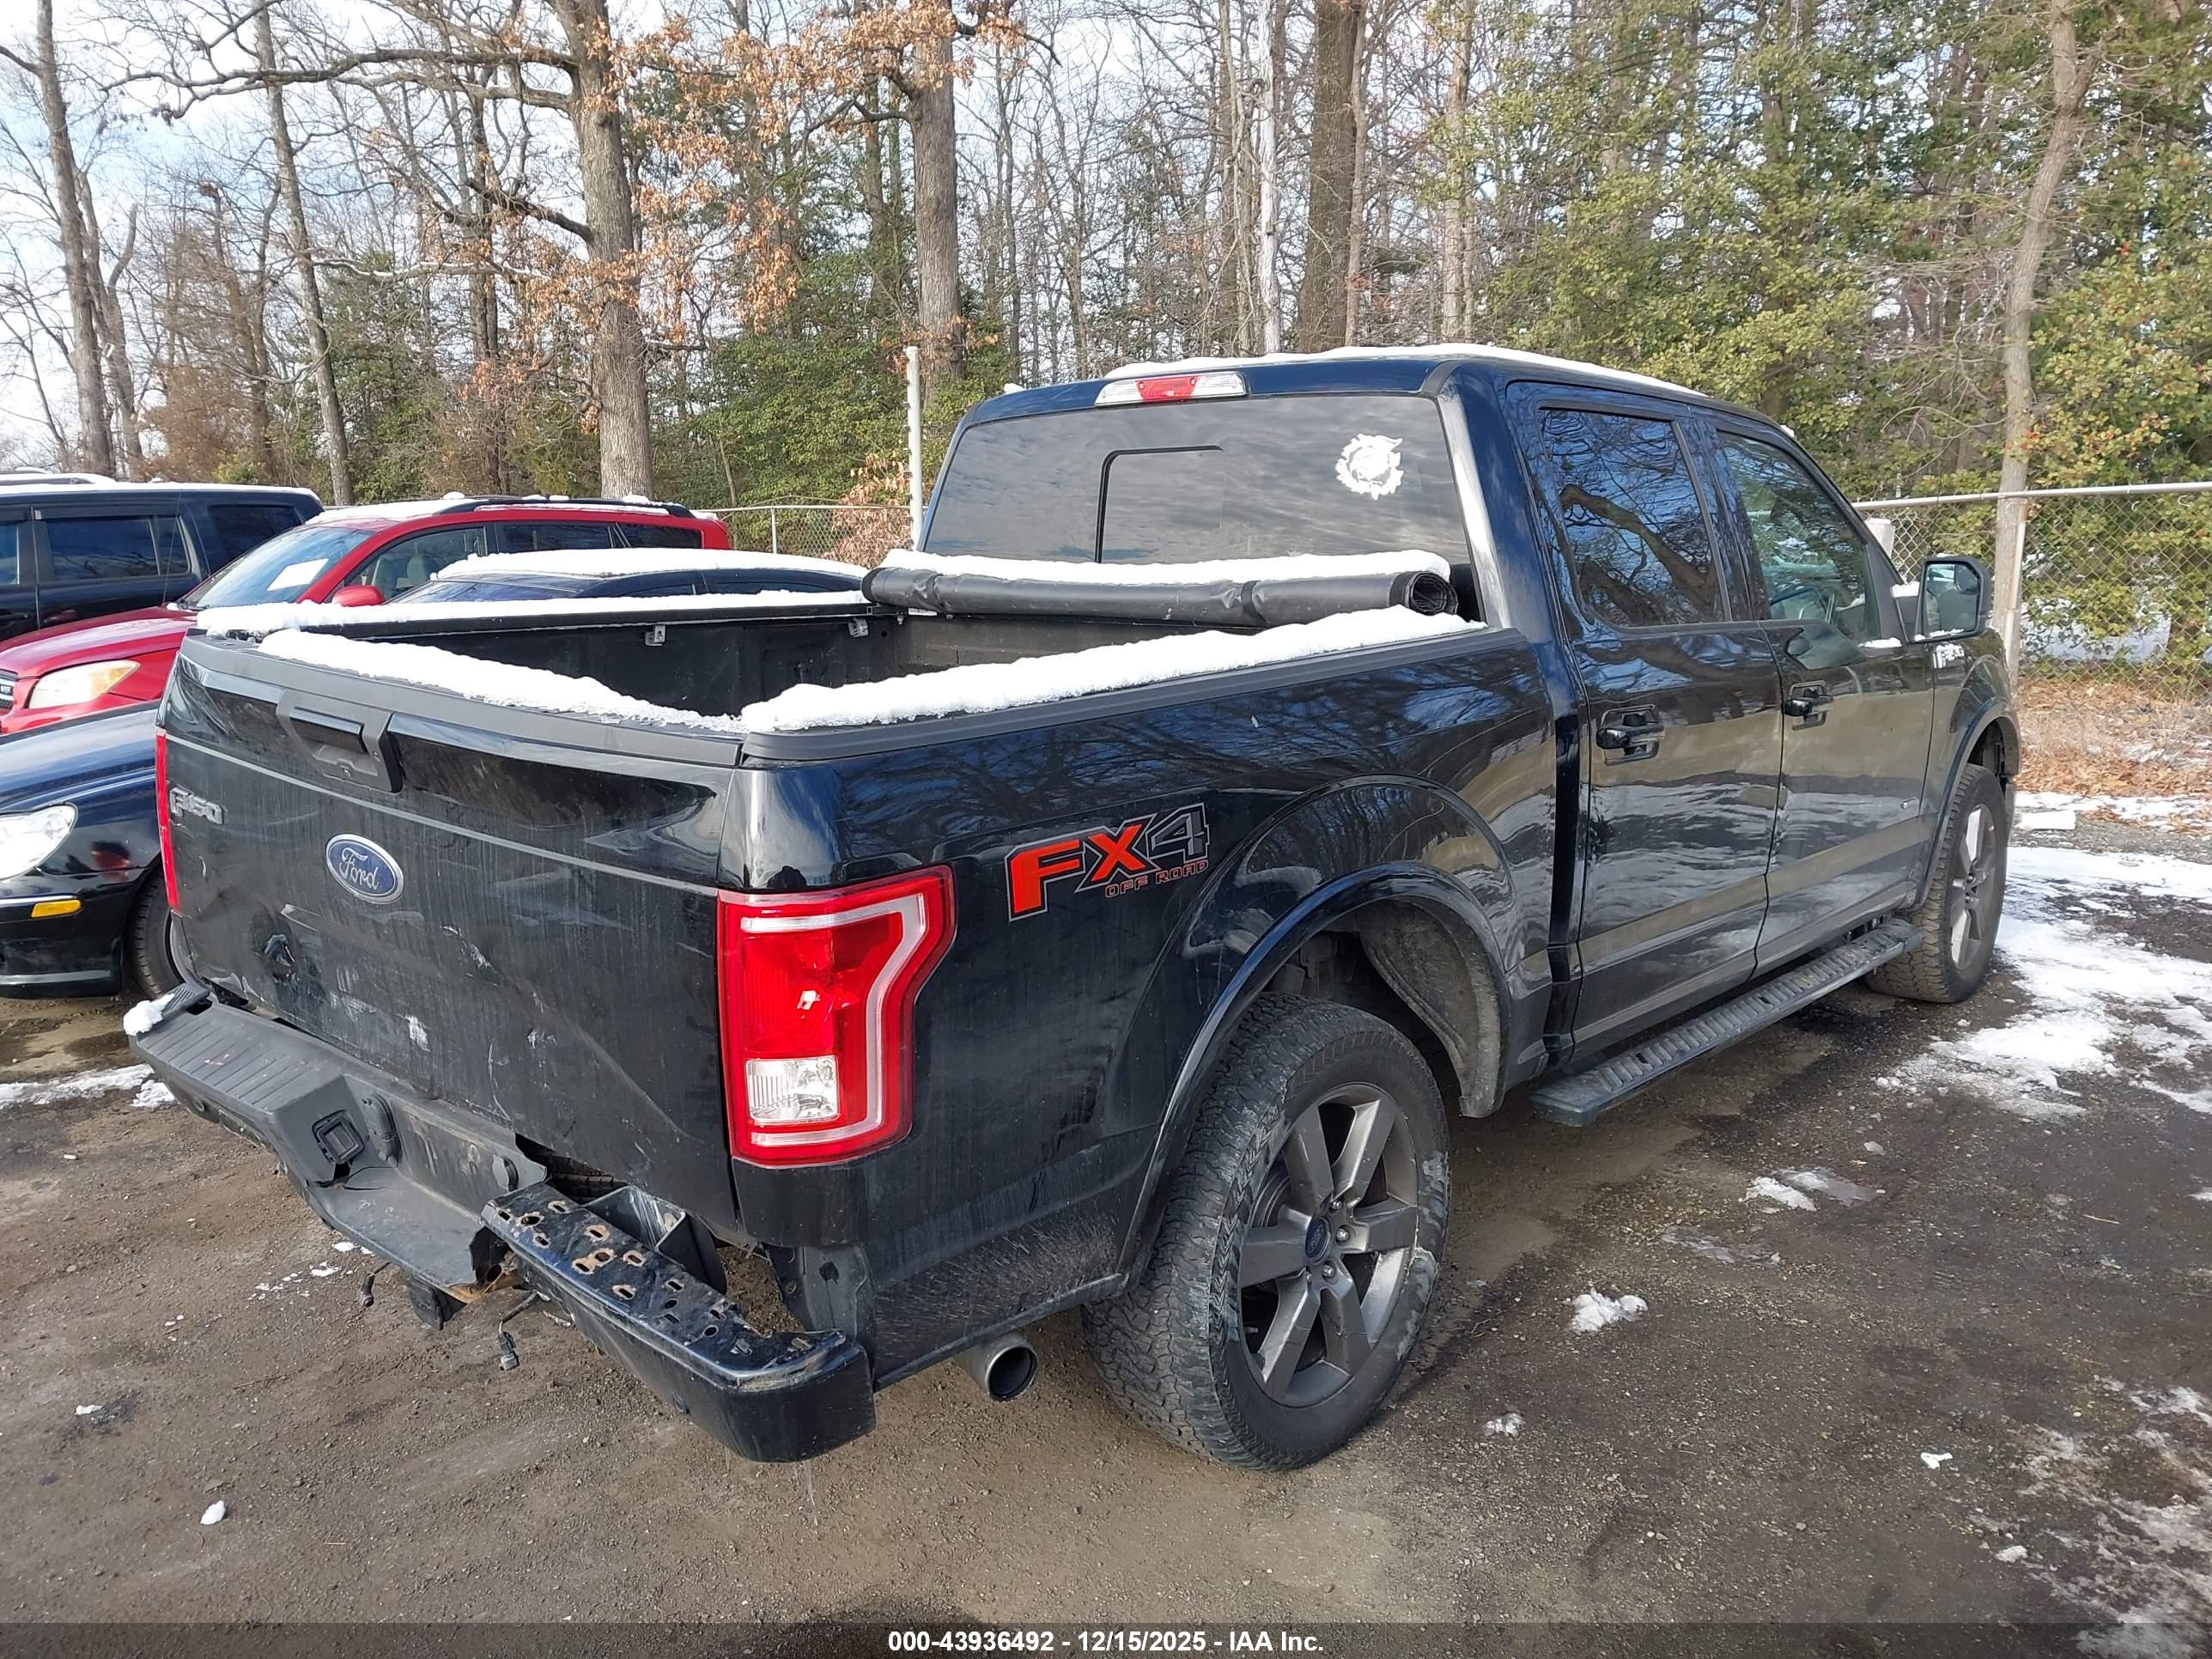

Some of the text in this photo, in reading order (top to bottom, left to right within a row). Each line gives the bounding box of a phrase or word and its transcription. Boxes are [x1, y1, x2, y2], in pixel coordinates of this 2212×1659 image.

[338, 847, 380, 890] Ford
[1005, 802, 1210, 922] FX4
[1104, 859, 1209, 898] OFF ROAD
